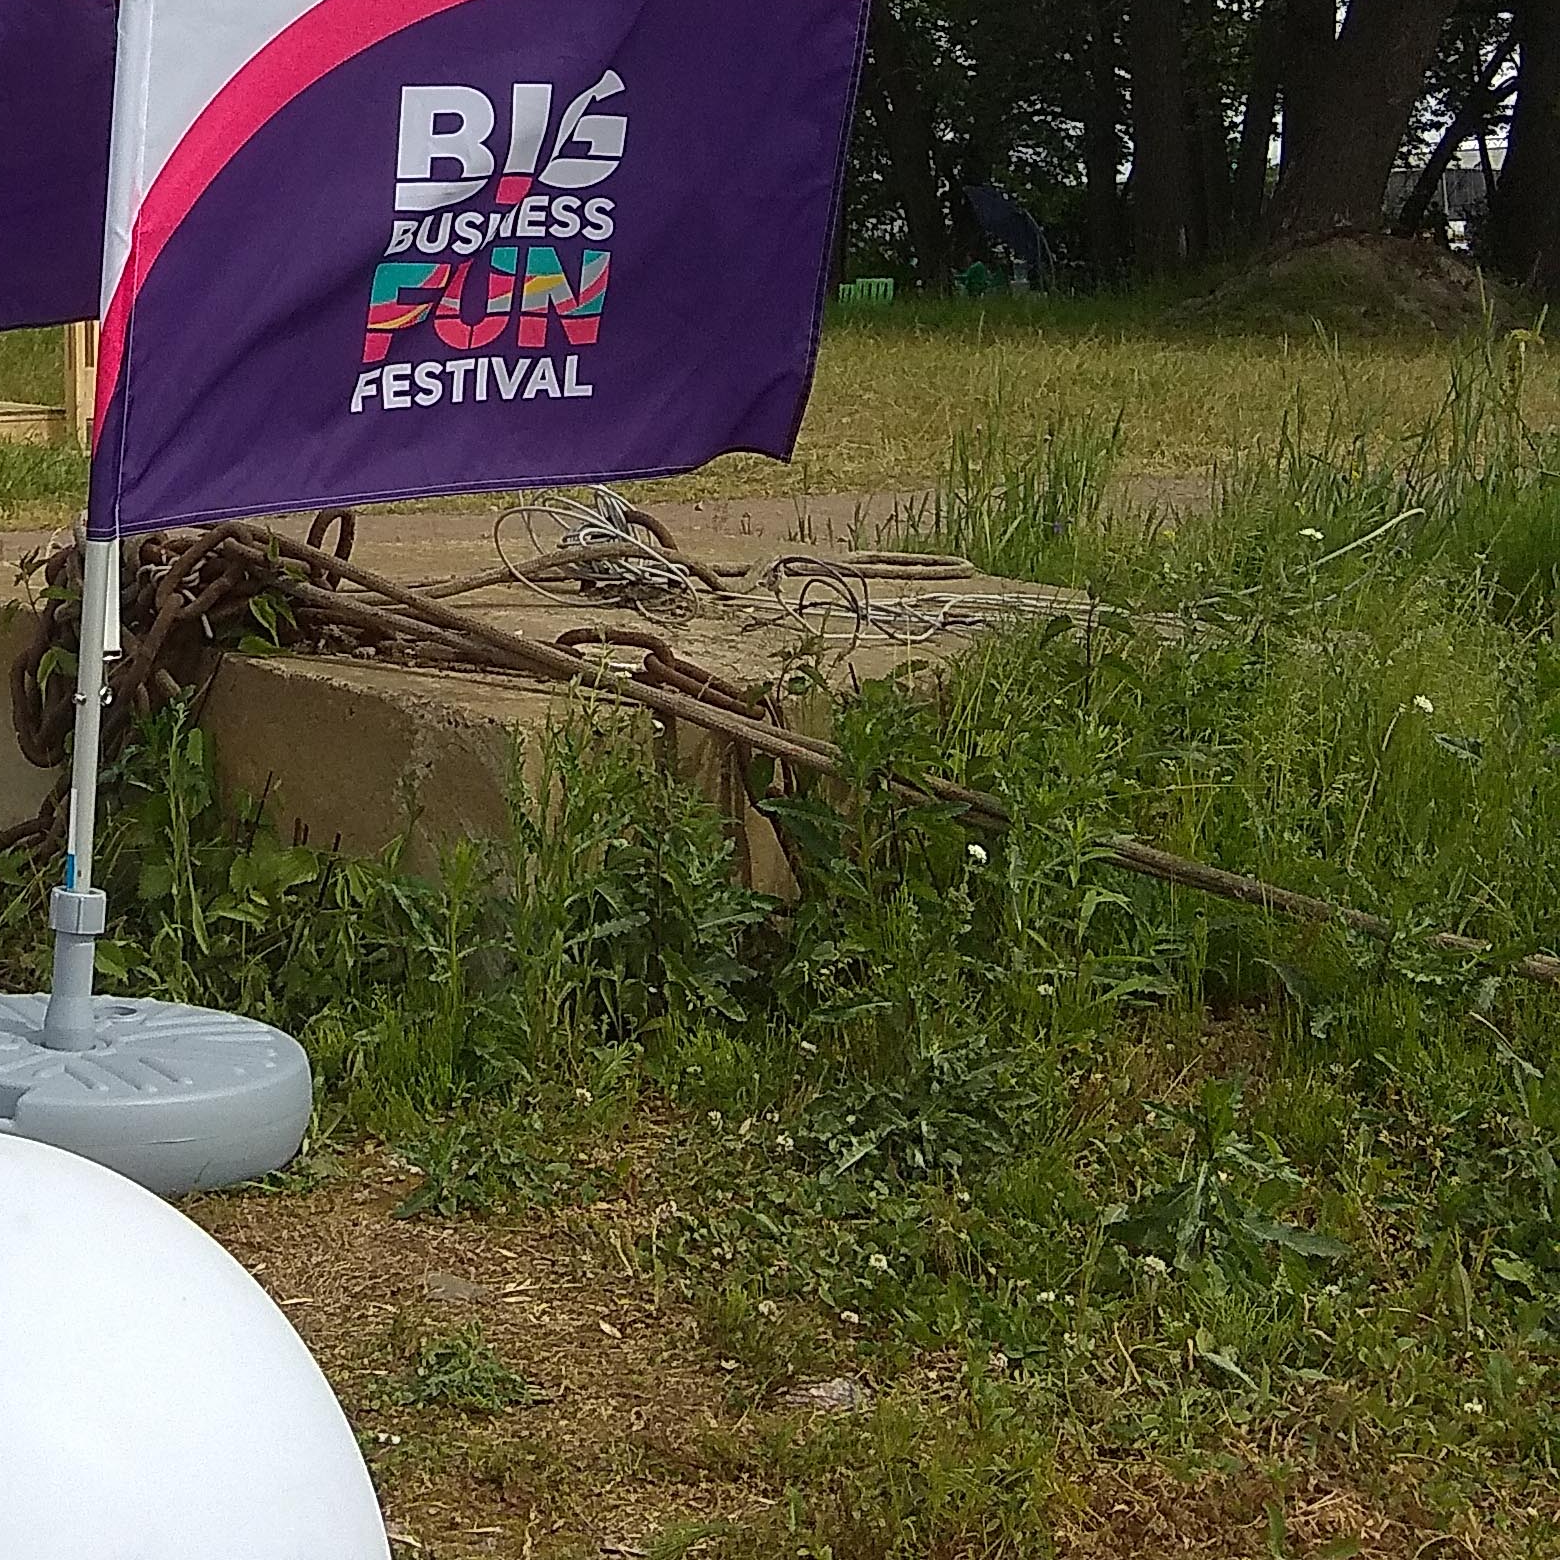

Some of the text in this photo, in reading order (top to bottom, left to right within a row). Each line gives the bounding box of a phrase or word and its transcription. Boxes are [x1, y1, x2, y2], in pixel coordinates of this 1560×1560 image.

[394, 69, 628, 211] BIG
[362, 246, 612, 364] FUN
[349, 354, 594, 413] FESTIVAL
